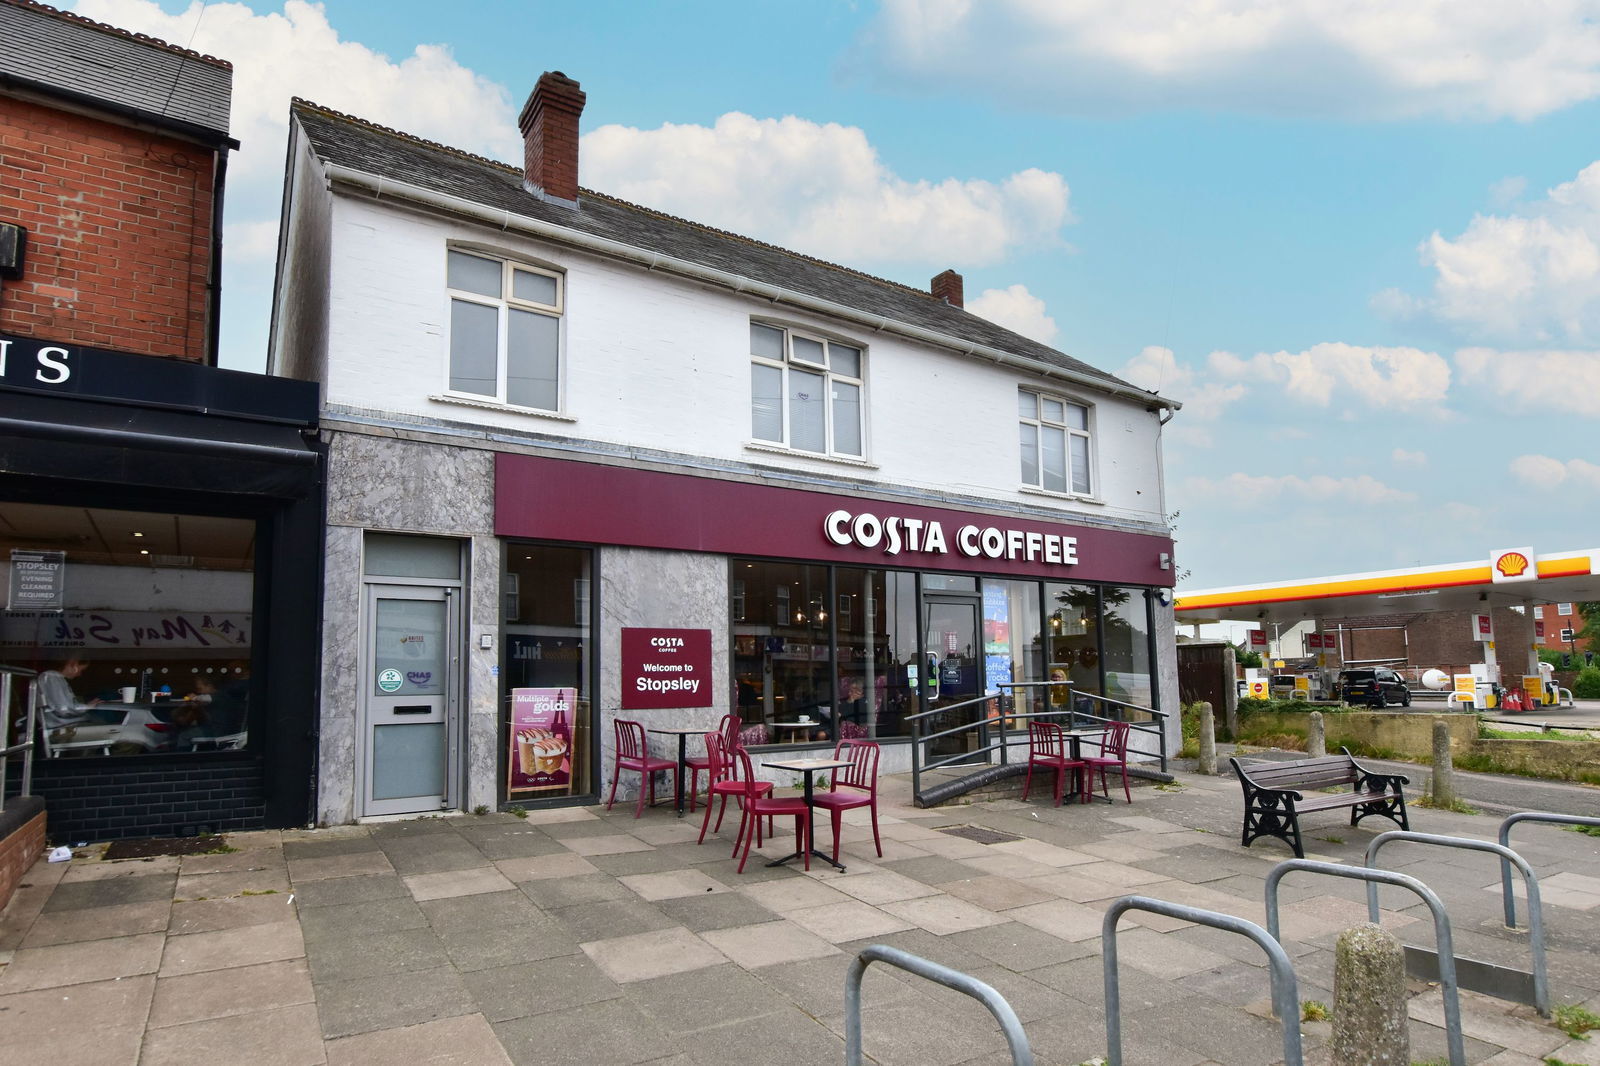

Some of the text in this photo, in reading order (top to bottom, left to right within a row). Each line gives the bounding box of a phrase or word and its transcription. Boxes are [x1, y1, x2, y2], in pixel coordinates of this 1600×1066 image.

[824, 509, 1079, 566] COSTA COFFEE
[16, 562, 60, 571] STOPSLEY
[21, 575, 54, 583] EVENING
[650, 637, 684, 648] COSTA
[643, 663, 693, 672] Welcome to
[406, 671, 431, 679] CHAS
[636, 676, 700, 694] Stopsley
[516, 695, 550, 703] Multiple
[532, 699, 570, 715] golds
